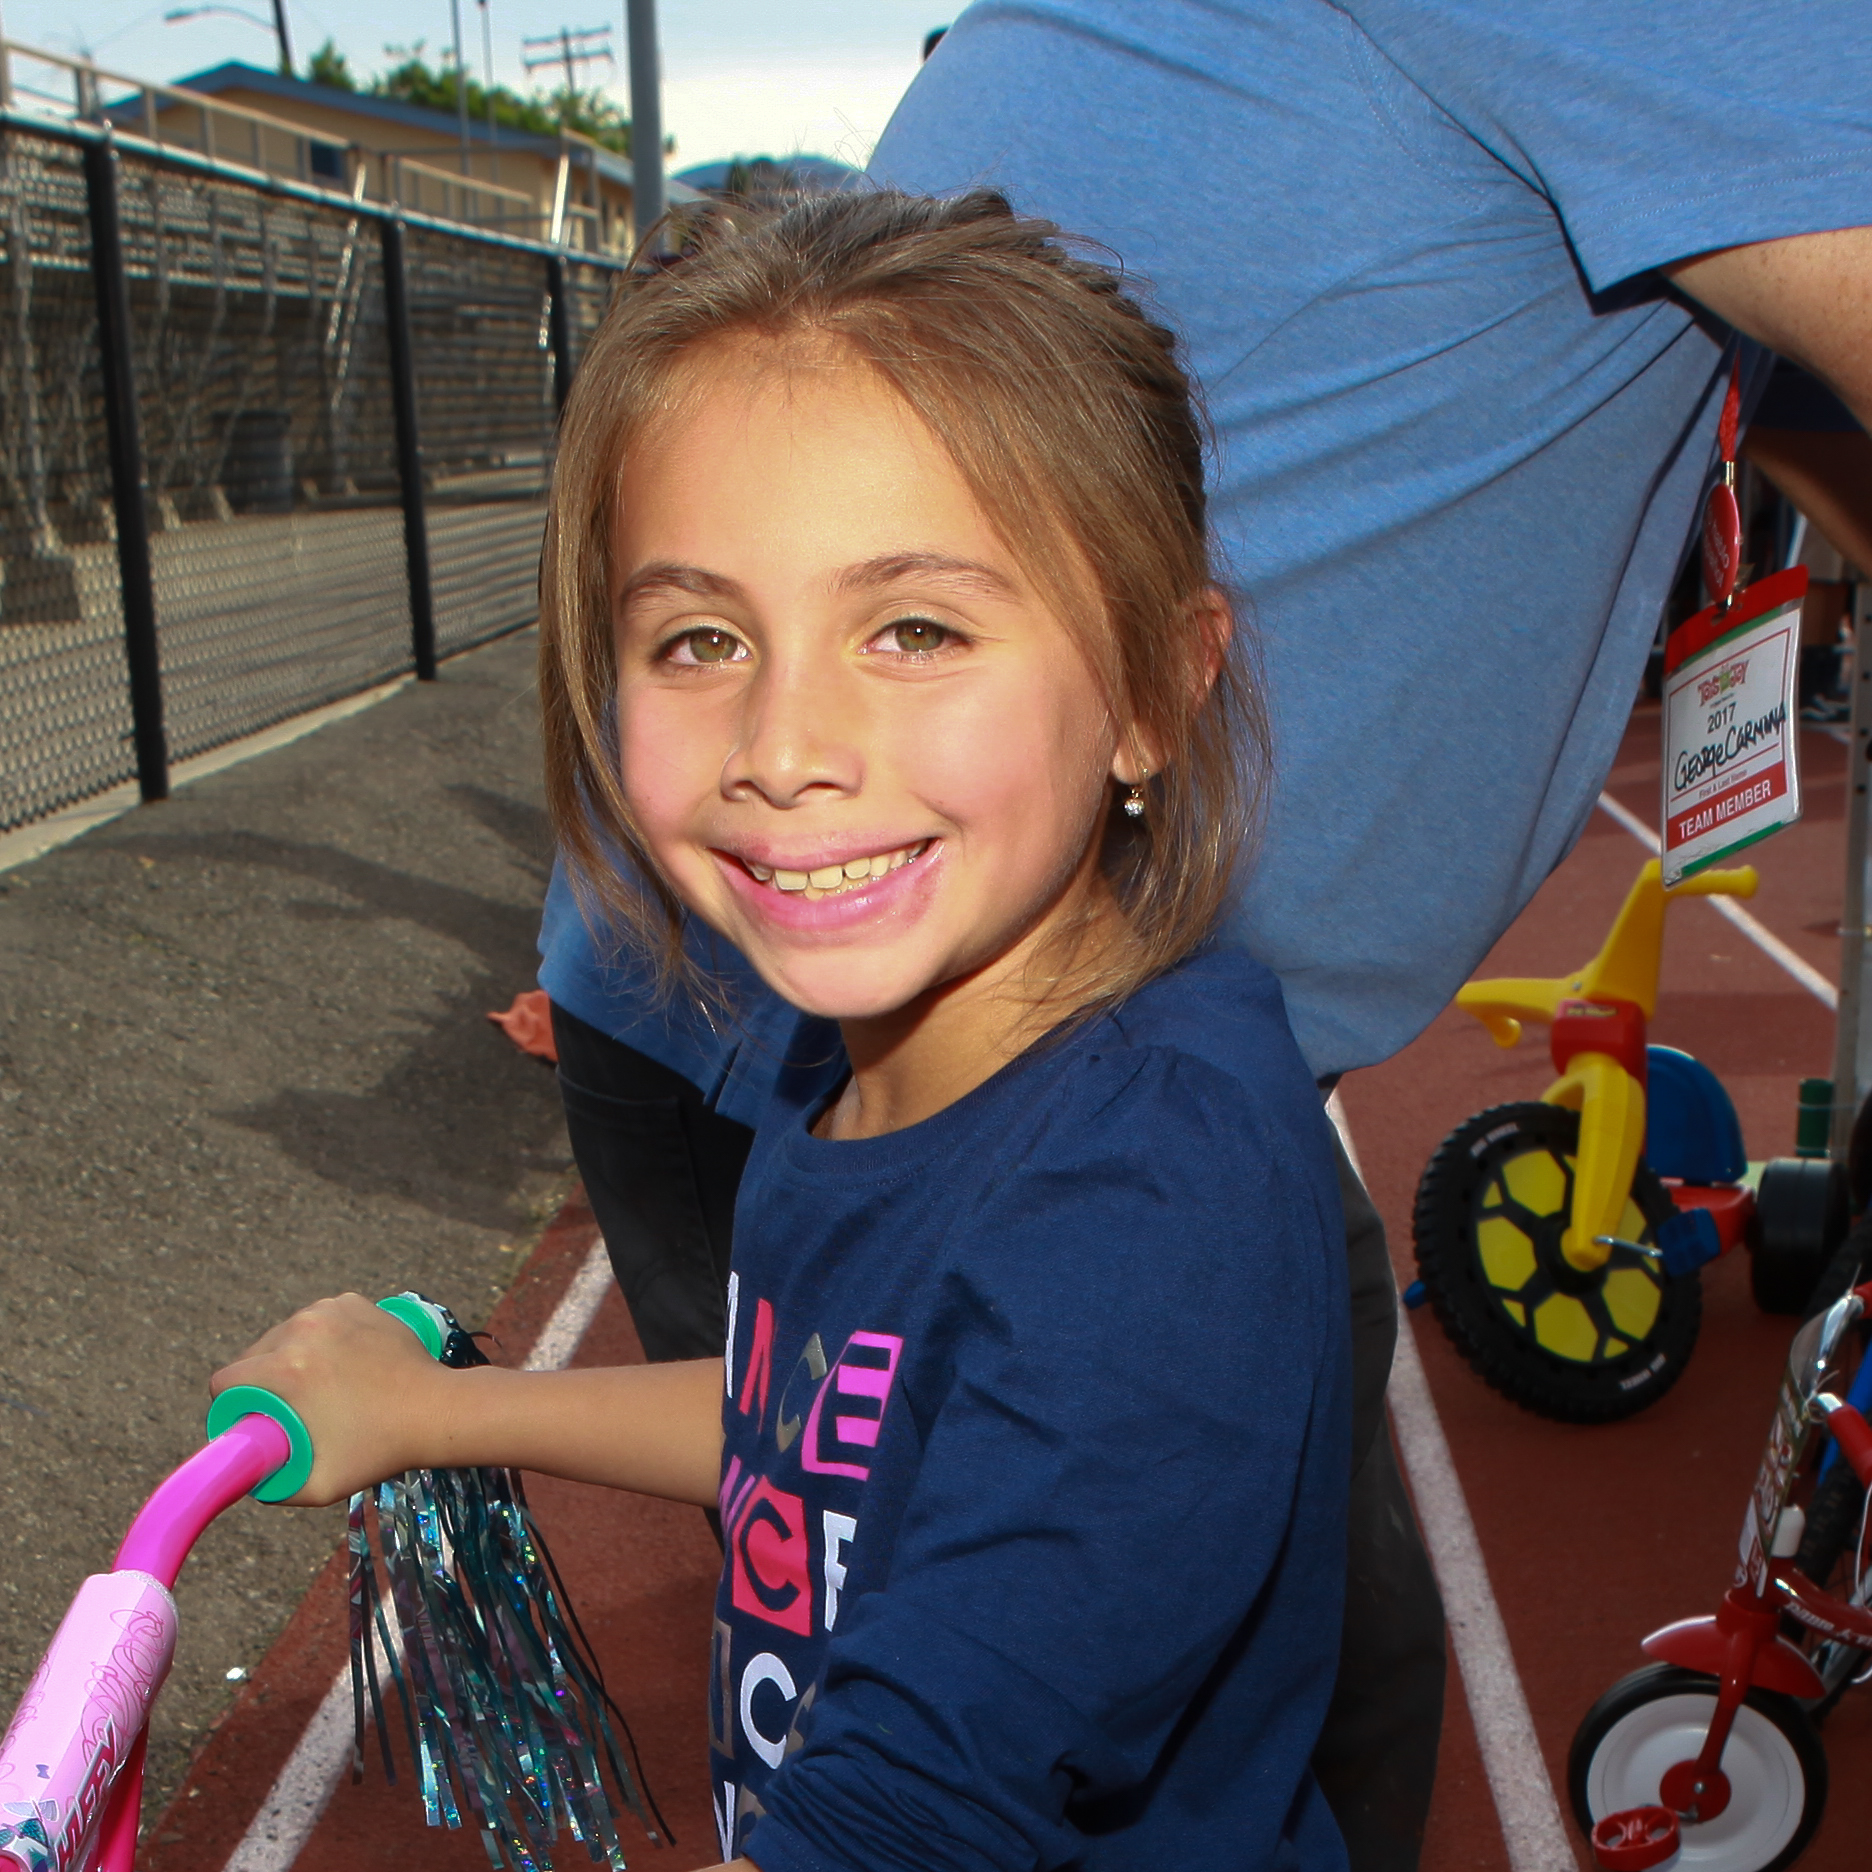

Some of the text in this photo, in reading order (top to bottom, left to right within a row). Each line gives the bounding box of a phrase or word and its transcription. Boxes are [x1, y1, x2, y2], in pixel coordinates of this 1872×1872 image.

[1707, 702, 1737, 734] 2017
[1679, 778, 1772, 840] TEAM MEMBER
